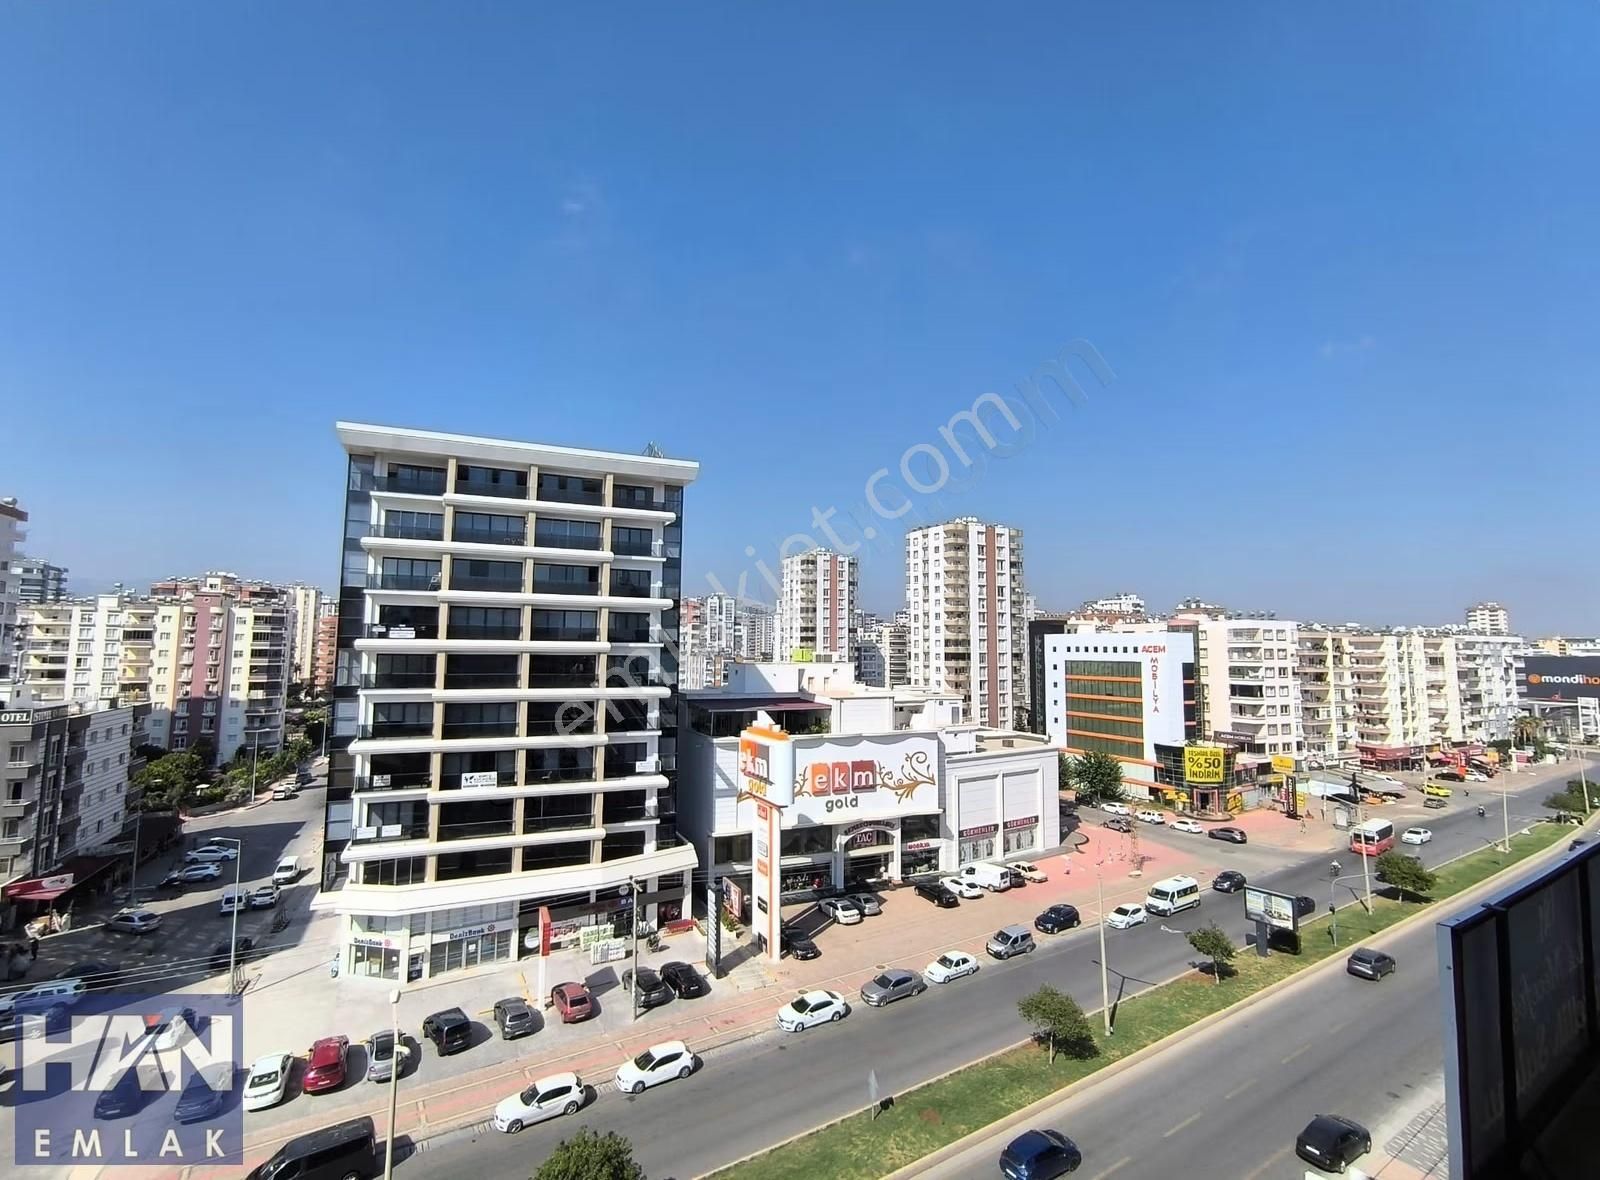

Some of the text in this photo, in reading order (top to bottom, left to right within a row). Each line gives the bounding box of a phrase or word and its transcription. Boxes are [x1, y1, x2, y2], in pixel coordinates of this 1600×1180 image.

[1142, 645, 1166, 653] ACEM
[1, 712, 29, 722] OTEL
[1188, 757, 1221, 769] %50
[815, 767, 873, 790] ekm
[825, 796, 859, 813] gold
[449, 928, 485, 940] DenizBank
